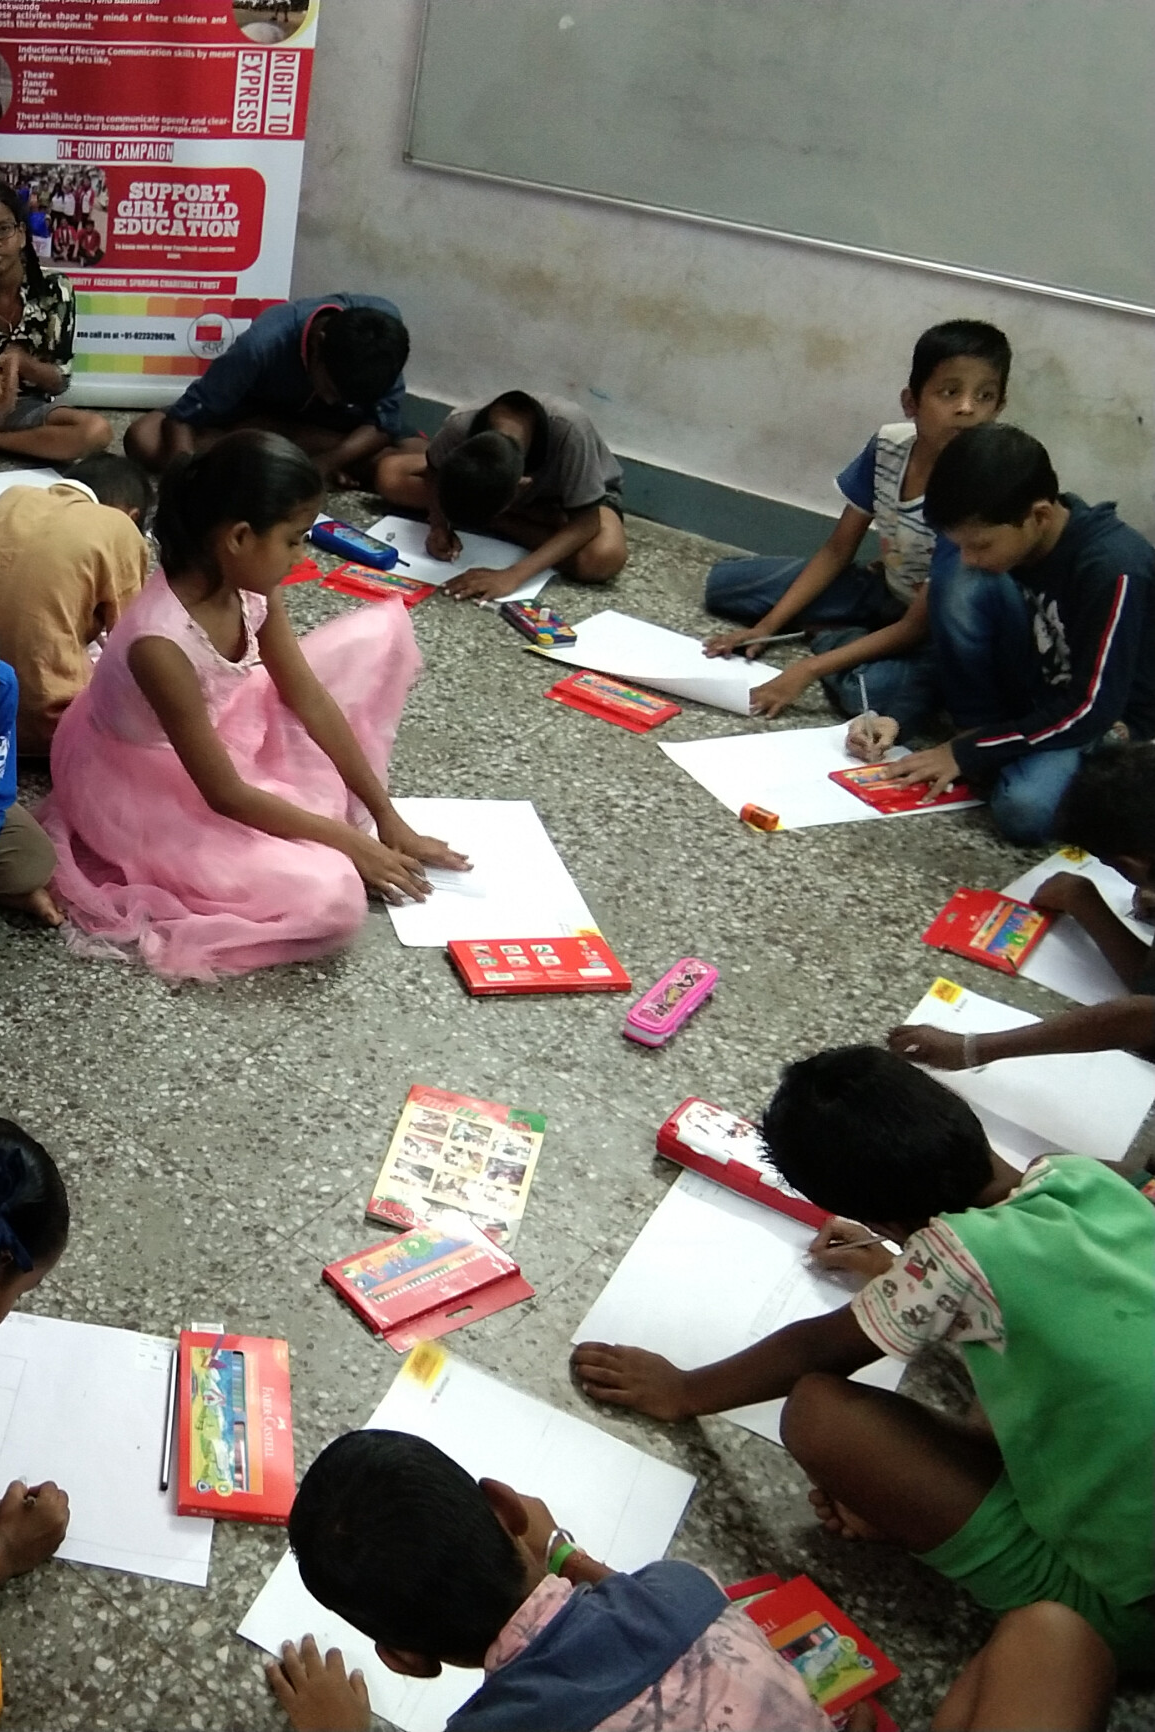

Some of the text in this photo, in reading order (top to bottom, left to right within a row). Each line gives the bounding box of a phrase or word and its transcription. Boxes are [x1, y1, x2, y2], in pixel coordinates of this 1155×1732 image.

[56, 12, 80, 21] shape
[85, 12, 98, 20] the
[103, 12, 128, 22] minds
[133, 13, 142, 22] of
[146, 14, 168, 22] these
[173, 14, 207, 24] children
[212, 15, 227, 24] and
[16, 20, 36, 28] their
[38, 20, 94, 30] development.
[18, 46, 58, 54] Induction
[60, 46, 68, 54] of
[70, 46, 106, 55] Effective
[108, 48, 172, 57] Communication
[174, 49, 195, 58] skills
[197, 50, 208, 60] by
[18, 54, 26, 62] of
[28, 55, 74, 64] Performing
[75, 56, 93, 64] Arts
[23, 70, 54, 79] Theatre
[22, 80, 47, 88] Dance
[22, 88, 58, 96] Fine Arts
[236, 52, 263, 133] EXPRESS
[268, 53, 296, 134] RIGHT TO
[22, 96, 44, 104] Music
[17, 113, 40, 121] These
[42, 113, 62, 122] skills
[64, 114, 82, 123] help
[83, 114, 104, 122] them
[106, 114, 160, 123] communicate
[162, 117, 189, 126] openly
[191, 117, 206, 126] and
[28, 121, 44, 129] also
[46, 122, 83, 130] enhances
[85, 122, 100, 130] and
[102, 123, 138, 132] broadens
[140, 124, 159, 132] their
[160, 124, 210, 134] perspective.
[57, 141, 174, 161] ON-GOING CAMPAIGN
[129, 182, 230, 202] SUPPORT
[117, 200, 238, 220] GIRL CHILD
[113, 218, 240, 238] EDUCATION
